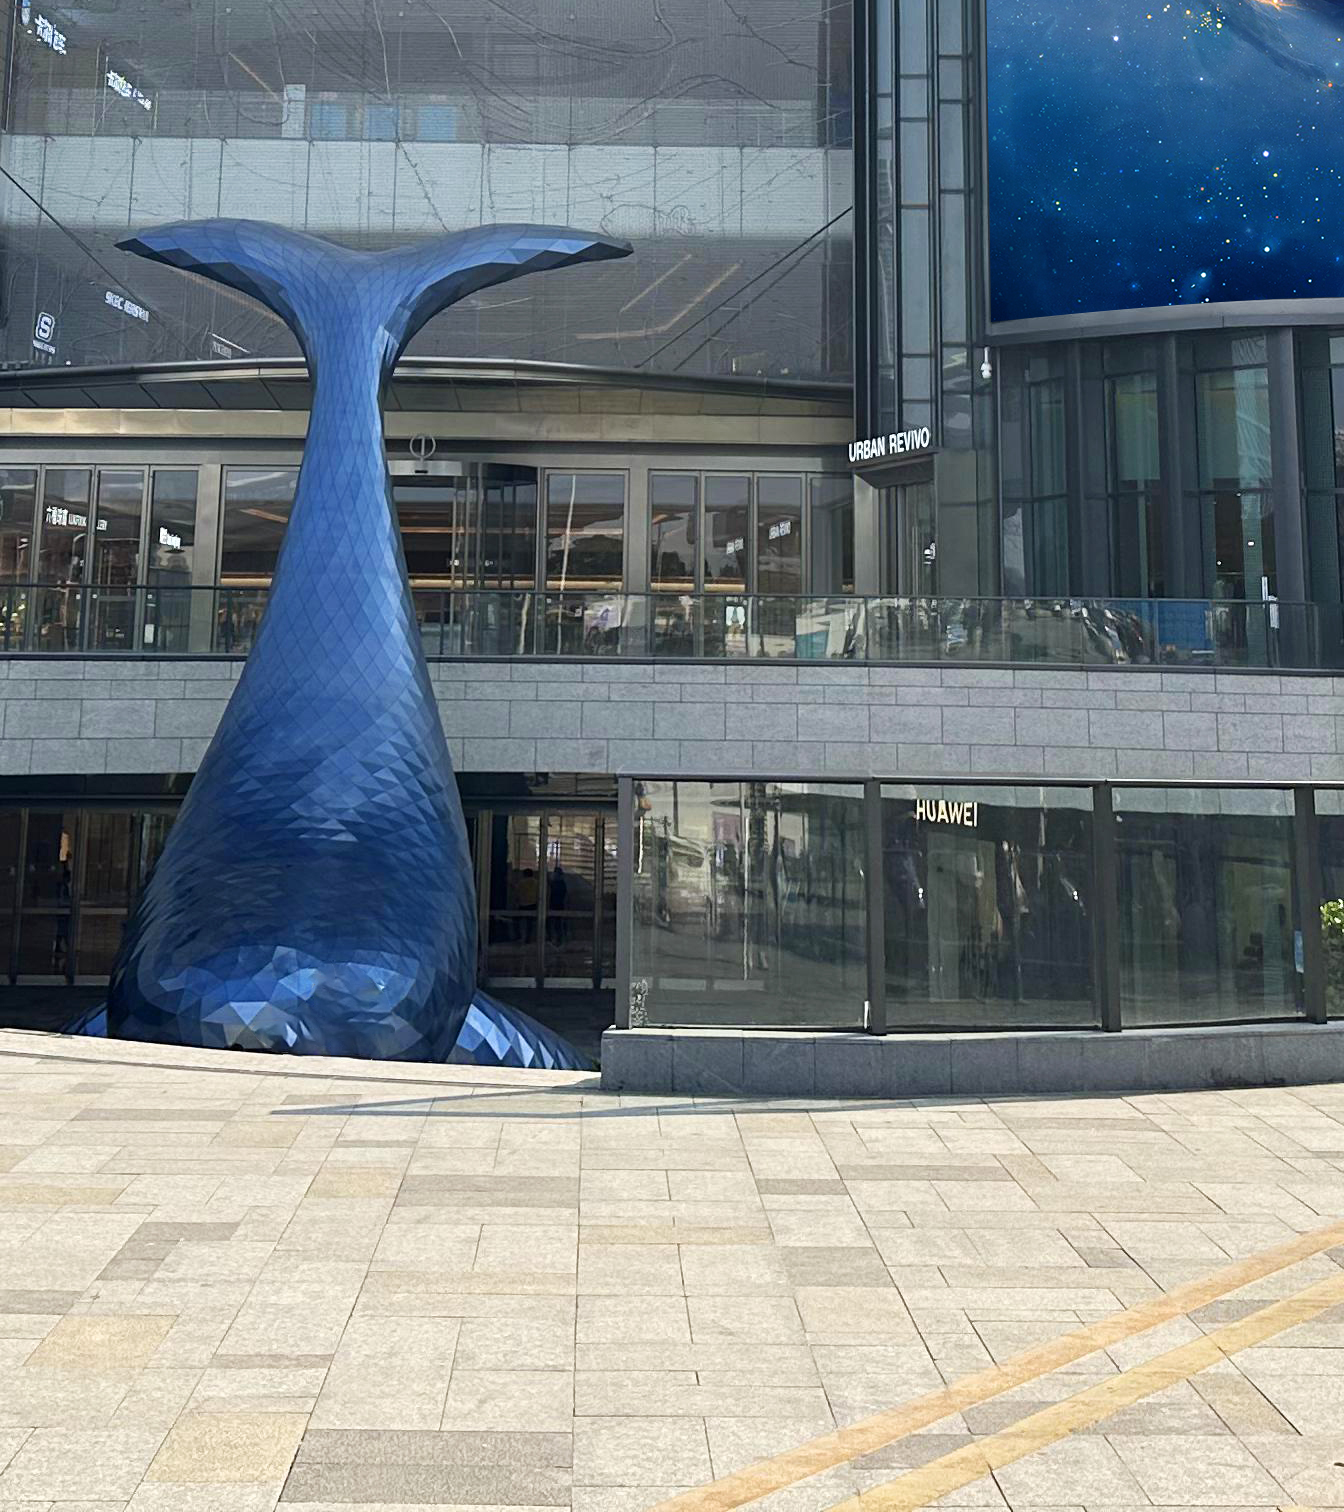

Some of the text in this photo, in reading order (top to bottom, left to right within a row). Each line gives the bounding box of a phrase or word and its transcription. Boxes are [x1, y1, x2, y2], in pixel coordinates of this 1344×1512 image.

[848, 426, 931, 463] URBAN REVIVO
[916, 798, 978, 828] HUAWEI
